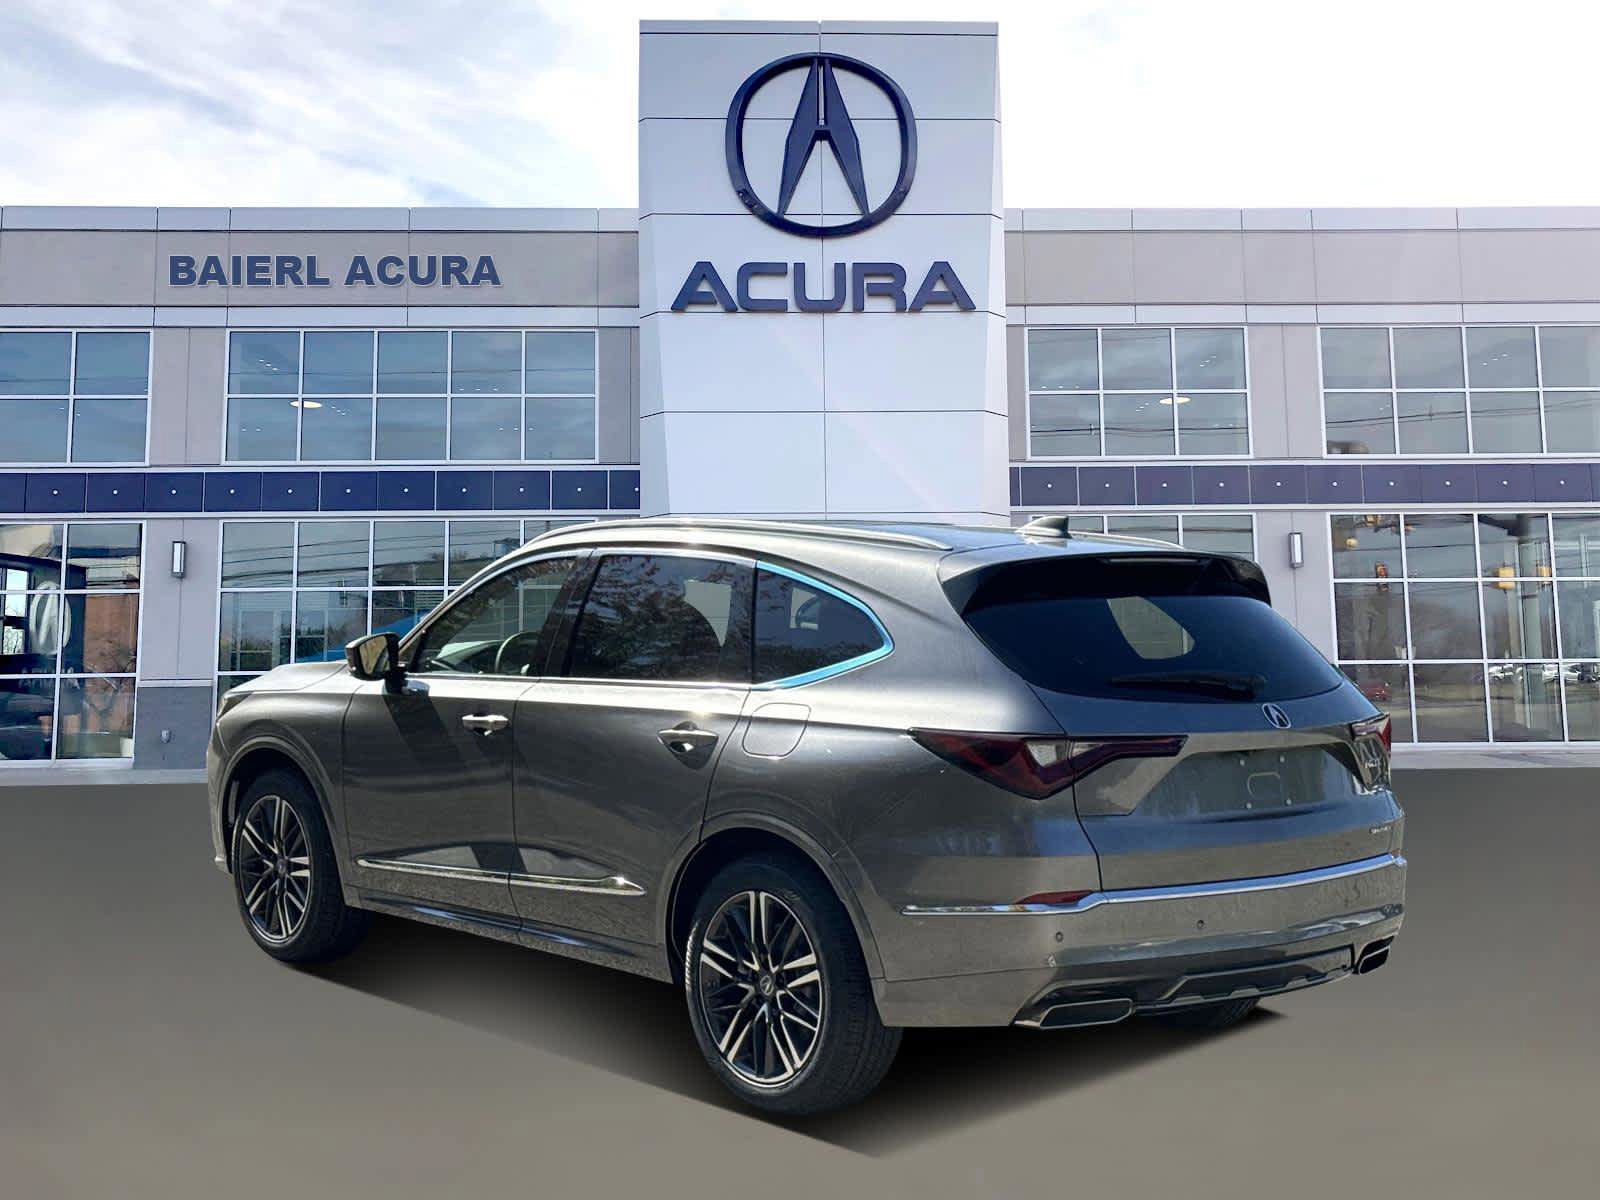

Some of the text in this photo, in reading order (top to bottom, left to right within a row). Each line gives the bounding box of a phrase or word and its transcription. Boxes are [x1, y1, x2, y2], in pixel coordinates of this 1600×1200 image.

[169, 255, 502, 287] BAIERL ACURA
[671, 261, 976, 313] ACURA
